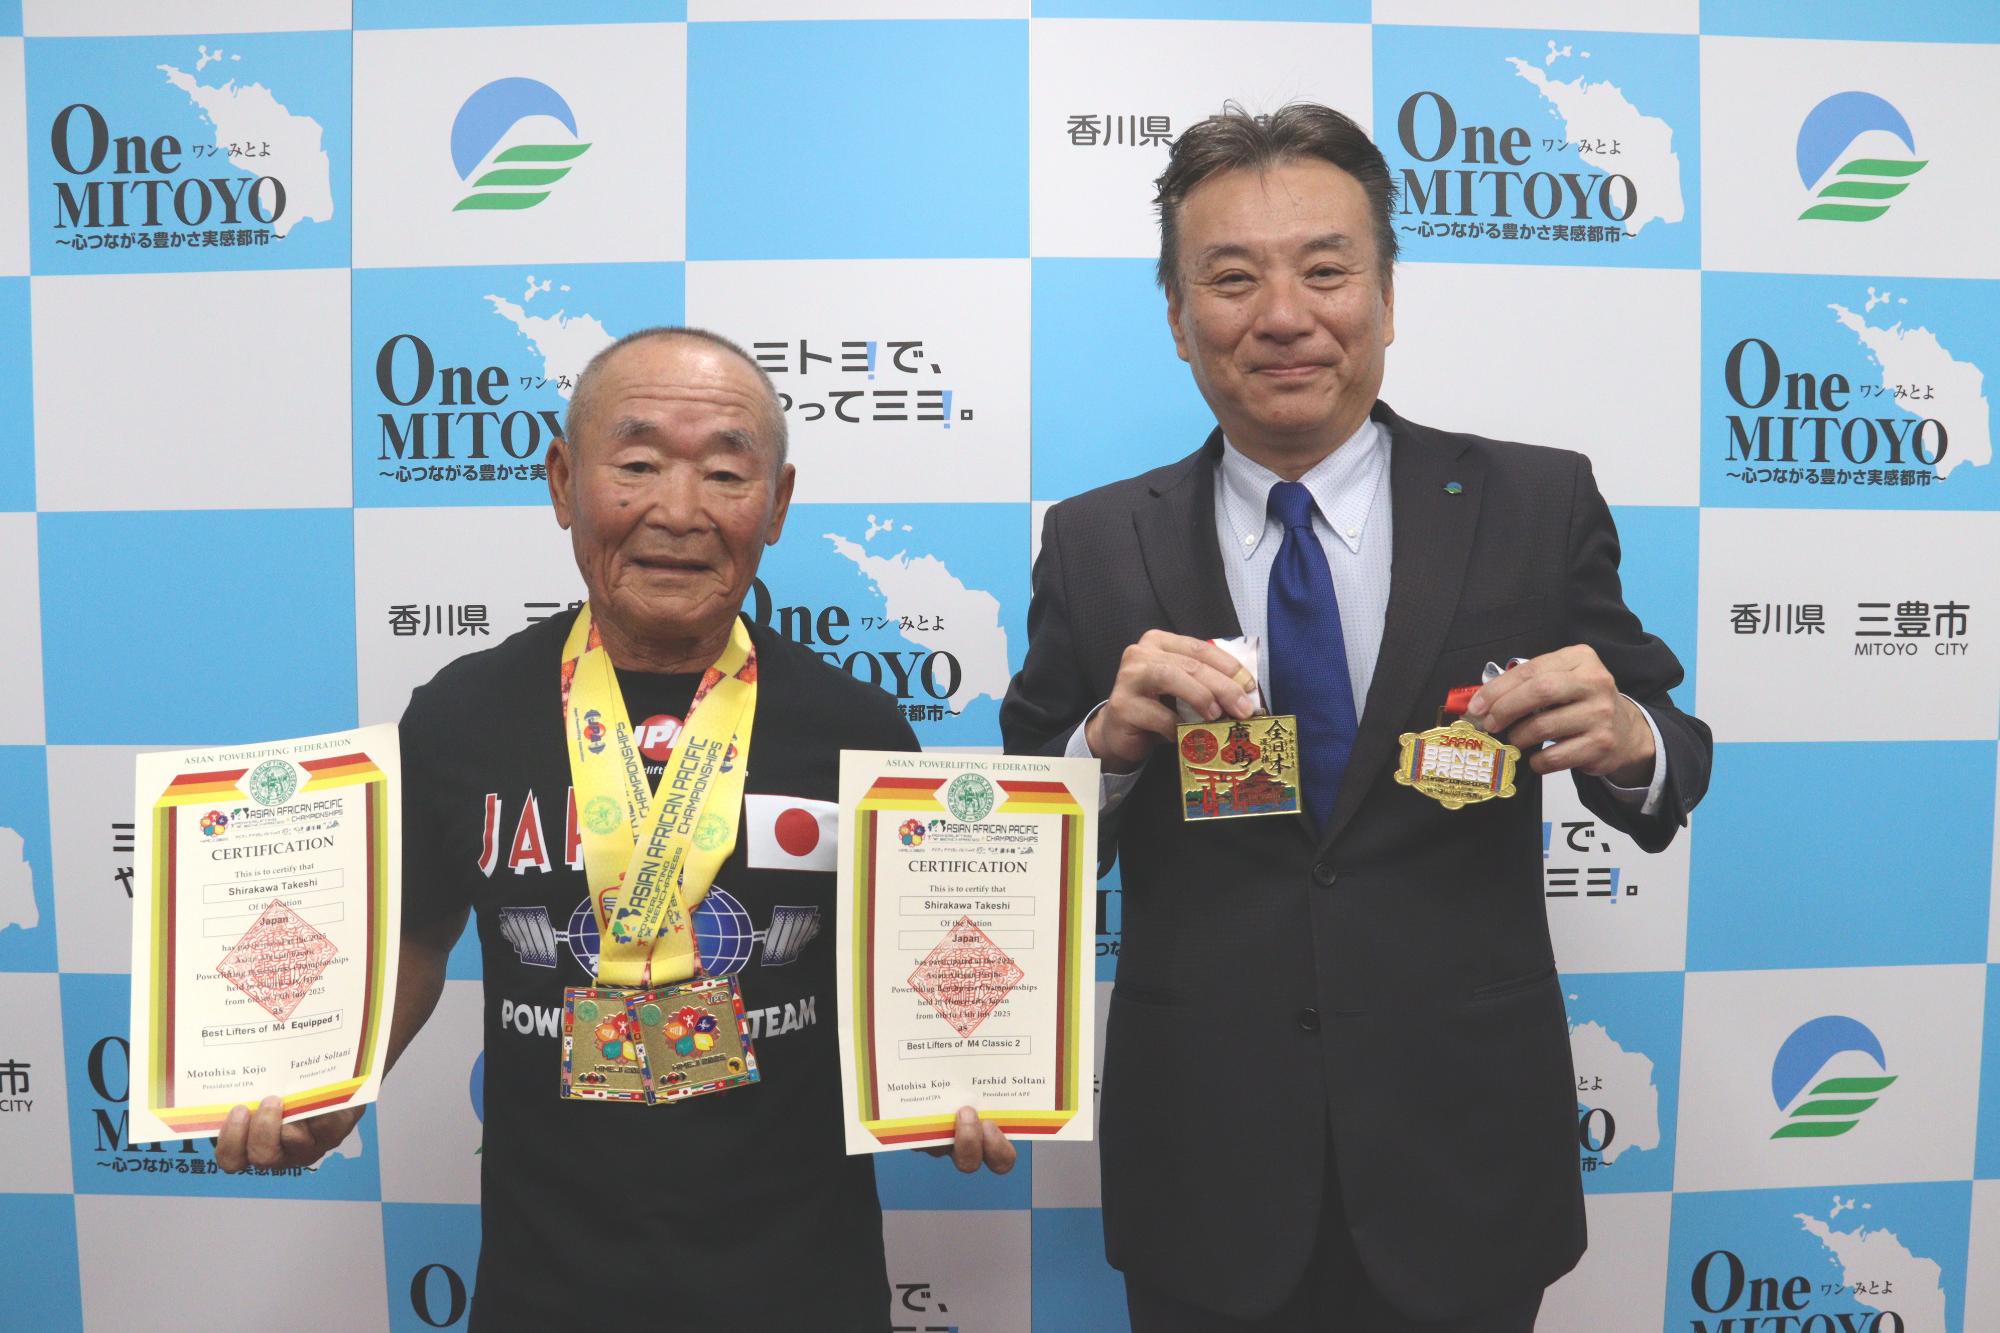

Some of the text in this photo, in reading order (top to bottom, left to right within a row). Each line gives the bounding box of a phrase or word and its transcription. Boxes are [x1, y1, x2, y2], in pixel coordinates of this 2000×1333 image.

[1067, 114, 1174, 147] 香川県
[1398, 91, 1532, 166] One
[51, 103, 182, 175] One
[1541, 139, 1622, 155] ワン みとよ
[192, 142, 271, 159] ワン みとよ
[53, 176, 287, 228] MITOYO
[1399, 168, 1638, 222] MITOYO
[376, 334, 510, 407] One
[1725, 338, 1850, 412] One
[1860, 384, 1935, 400] ワン みとよ
[1725, 415, 1948, 466] MITOYO
[388, 604, 490, 636] 香川県
[898, 615, 945, 631] みとよ
[1730, 600, 1970, 638] 香川県 三豊市
[1854, 643, 1968, 656] MITOYO CITY
[1440, 736, 1483, 750] JAPAN
[184, 738, 351, 766] ASIAN POWERLIFTING FEDERATION
[1425, 745, 1494, 767] BENCH
[886, 759, 1052, 772] ASIAN POWERLIFTING FEDERATION
[1422, 761, 1491, 783] PRESS
[677, 741, 723, 835] CHAMPIONSHIPS
[630, 861, 661, 909] ASIAN
[647, 793, 686, 858] AFRICAN
[672, 736, 708, 790] PACIFIC
[947, 823, 1039, 835] ASIAN AFRICAN PACIFIC
[211, 835, 334, 861] CERTIFICATION
[235, 871, 252, 880] This
[273, 865, 297, 876] certify
[299, 863, 314, 871] that
[908, 860, 1028, 873] CERTIFICATION
[228, 878, 318, 896] Shirakawa Takeshi
[650, 848, 683, 924] BENCHPRESS
[929, 885, 946, 893] This
[965, 885, 989, 894] certify
[991, 885, 1006, 893] that
[248, 903, 259, 911] Of
[637, 861, 670, 938] POWERLIFTING
[924, 900, 1010, 910] Shirakawa Takeshi
[260, 916, 289, 927] Japan
[940, 919, 951, 927] Of
[952, 934, 980, 944] Japan
[225, 998, 245, 1006] from
[748, 996, 817, 1038] TEAM
[916, 1012, 934, 1020] from
[993, 1010, 1011, 1018] 2025
[201, 1029, 223, 1038] Best
[226, 1026, 256, 1036] Lifters
[258, 1025, 268, 1033] of
[272, 1024, 286, 1032] M4
[291, 1015, 333, 1030] Equipped
[907, 1039, 1021, 1050] Best Lifters of M4 Classic 2
[290, 1047, 352, 1070] Farshid Soltani
[187, 1065, 267, 1079] Motohisa Kojo
[972, 1076, 1046, 1085] Farshid Soltani
[887, 1080, 951, 1092] Motohisa Kojo
[1691, 1250, 1811, 1313] One
[1821, 1280, 1893, 1296] ワン みとよ
